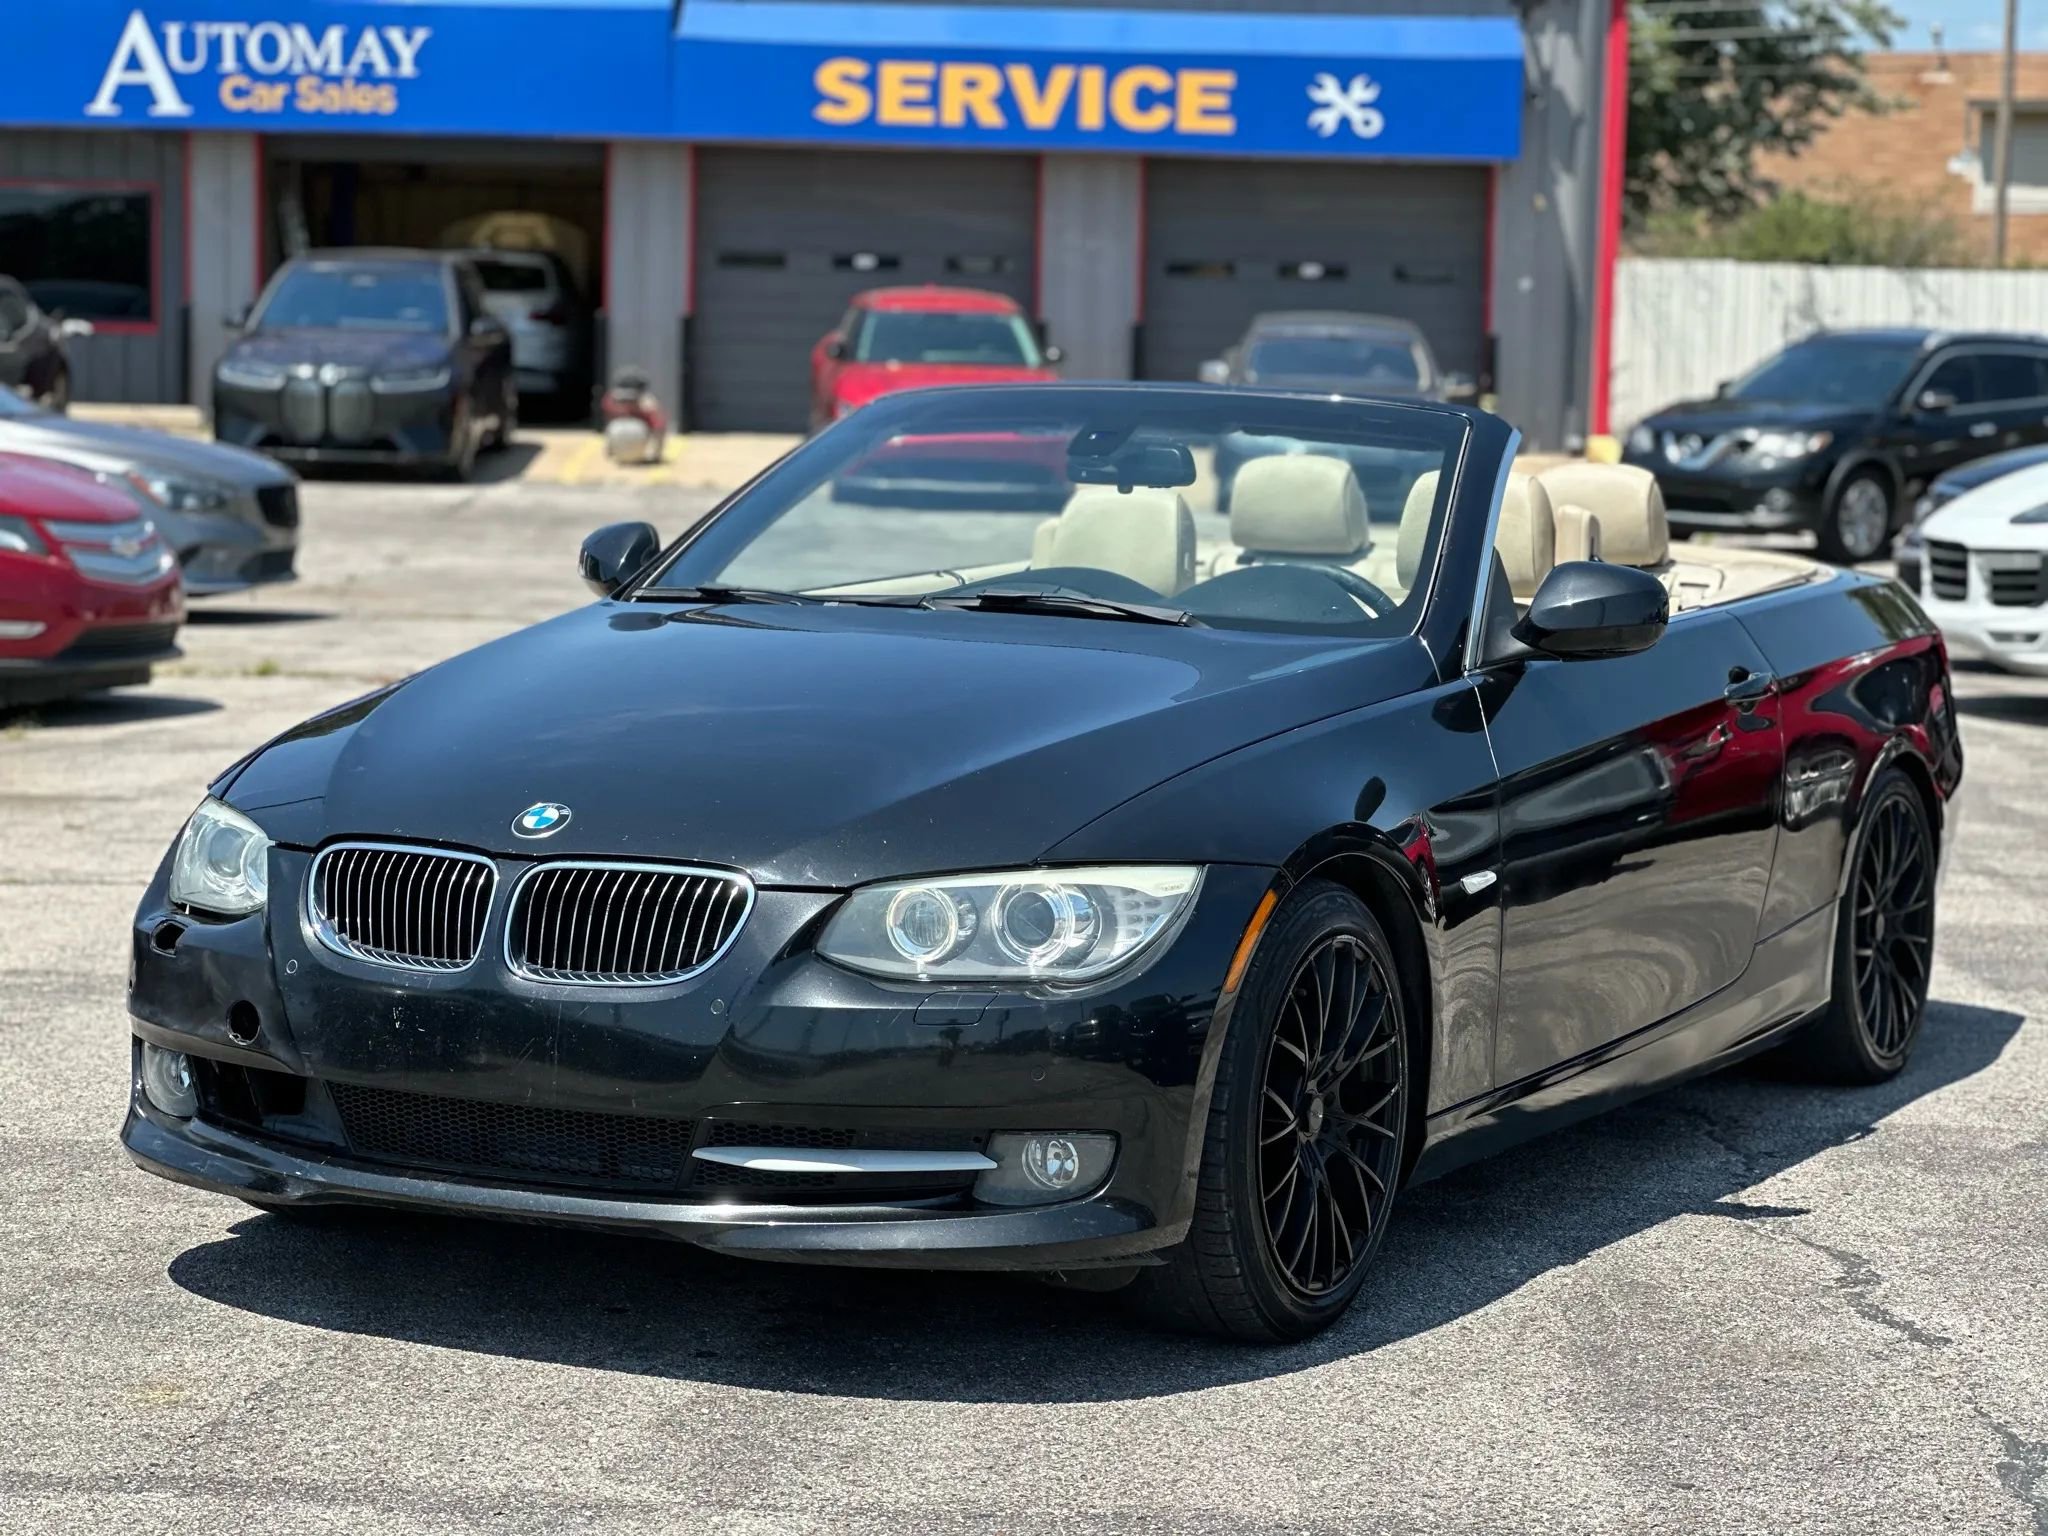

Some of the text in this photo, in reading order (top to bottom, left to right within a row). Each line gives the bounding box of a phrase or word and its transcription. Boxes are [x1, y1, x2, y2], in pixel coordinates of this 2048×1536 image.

[85, 9, 431, 117] AUTOMAY
[219, 75, 398, 115] Car Sales
[813, 57, 1236, 135] SERVICE
